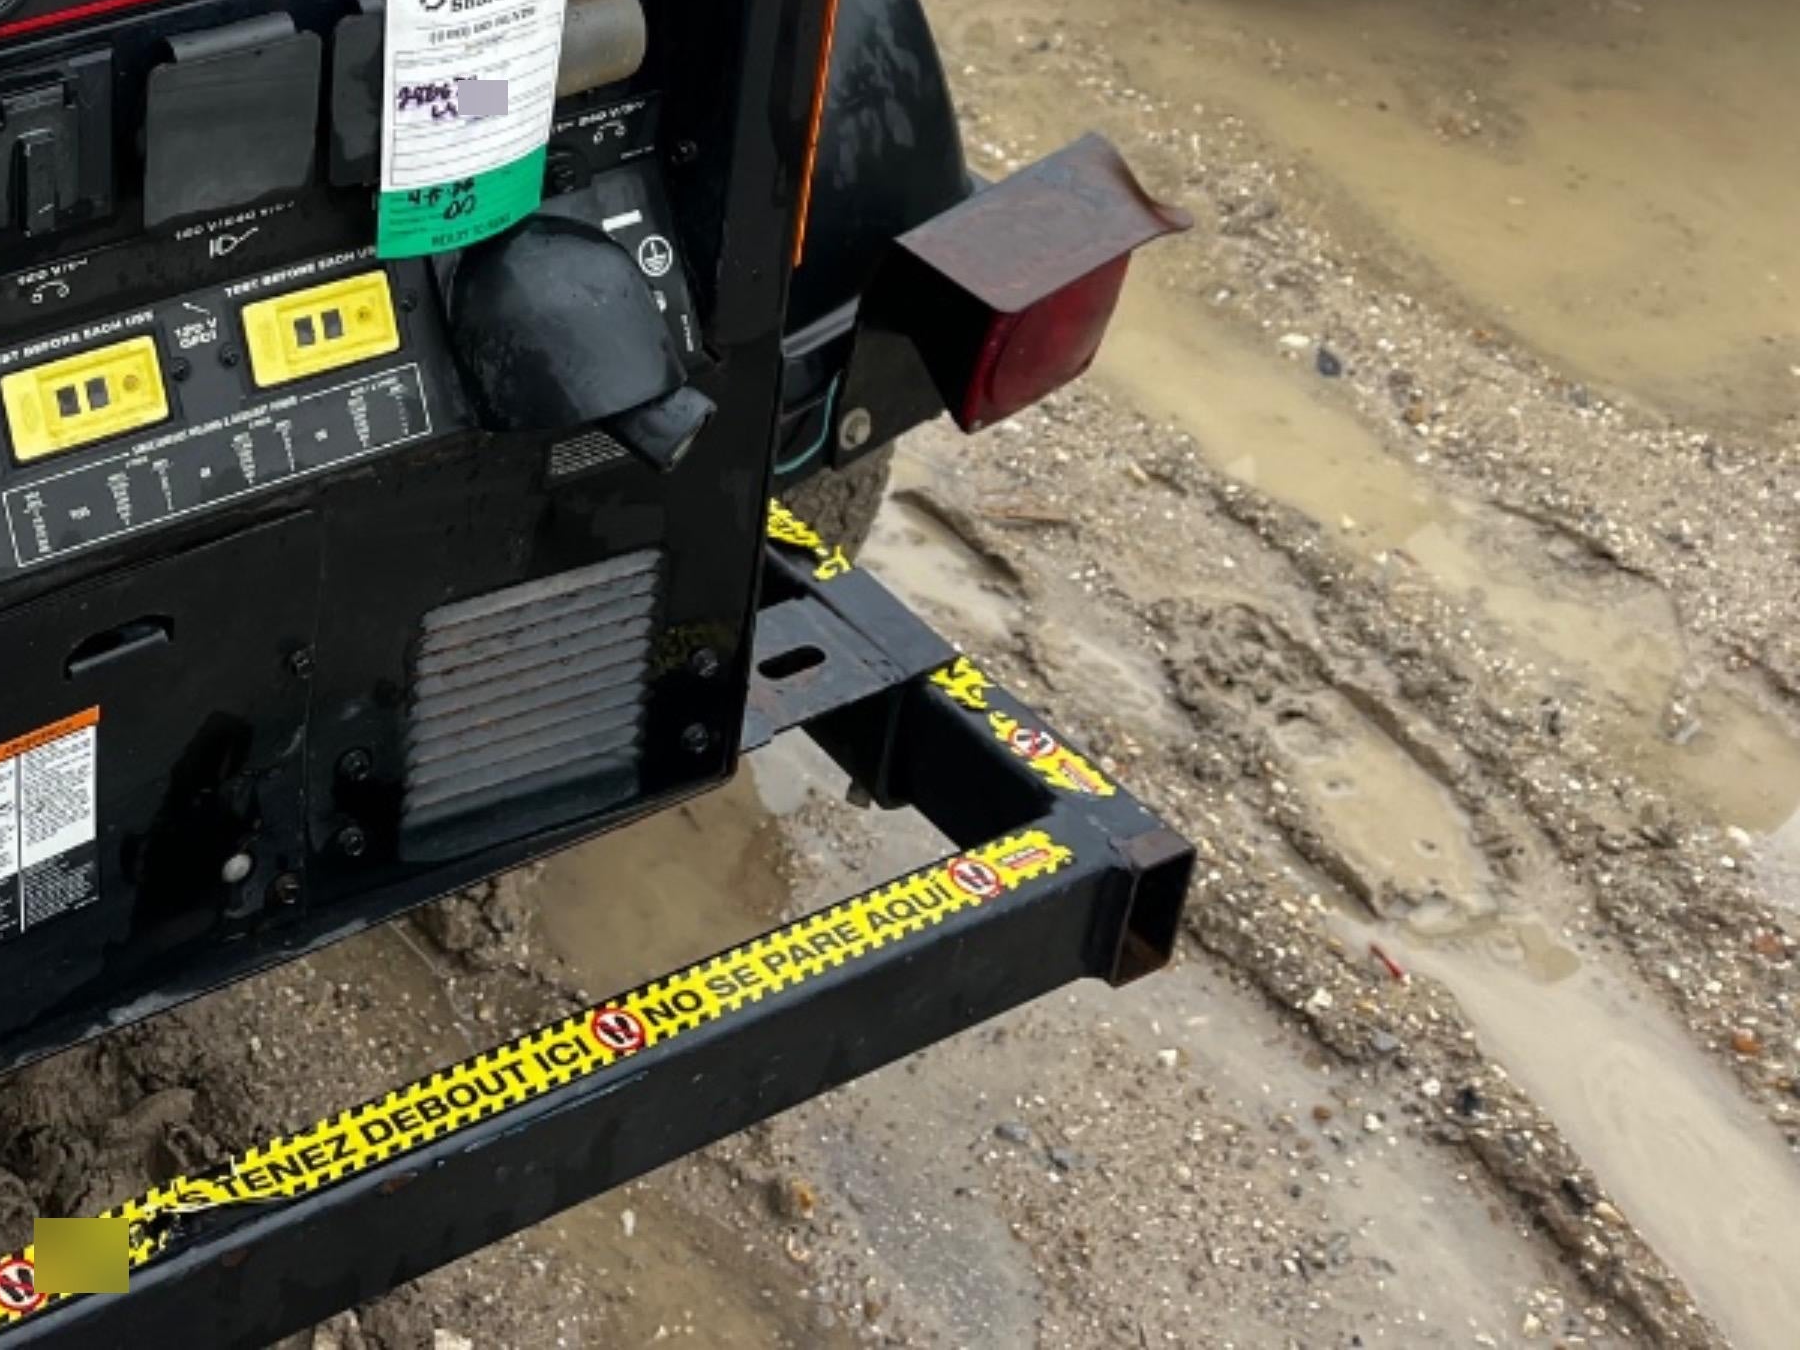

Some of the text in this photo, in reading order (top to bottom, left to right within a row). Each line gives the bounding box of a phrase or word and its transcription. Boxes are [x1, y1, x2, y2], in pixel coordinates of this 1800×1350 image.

[261, 260, 316, 286] BEFORE
[317, 252, 355, 270] EACH
[23, 331, 81, 359] BEFORE
[83, 320, 122, 340] EACH
[356, 1062, 529, 1144] DEBOUT
[535, 1037, 593, 1075] ICI
[643, 988, 705, 1030] NO
[713, 960, 764, 1001] SE
[767, 920, 863, 975] PARE
